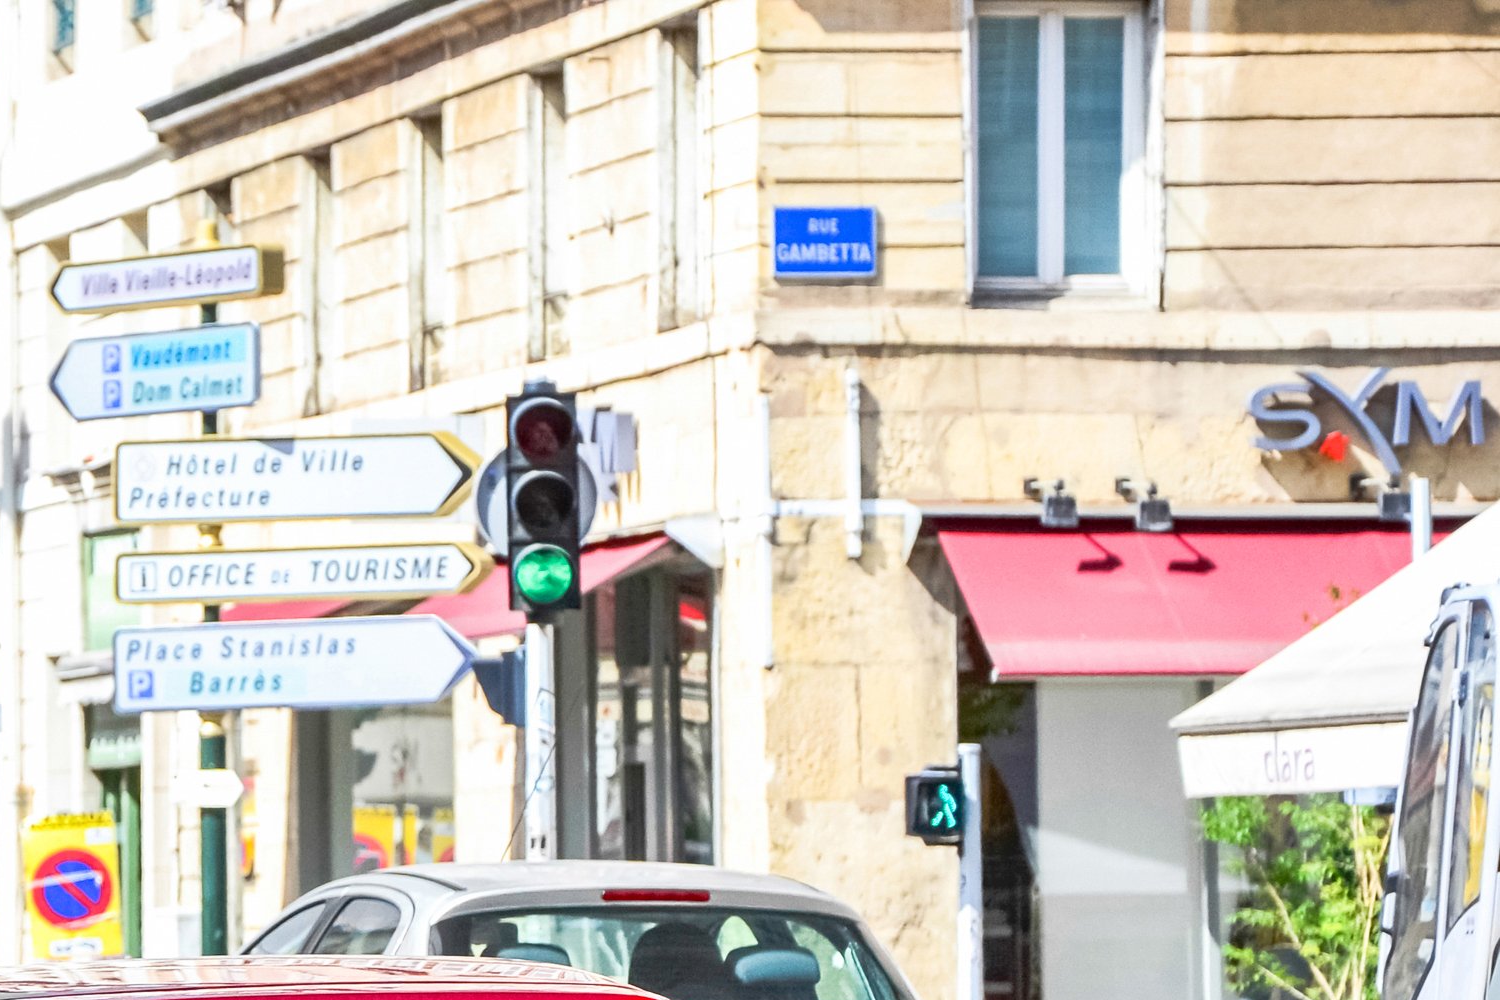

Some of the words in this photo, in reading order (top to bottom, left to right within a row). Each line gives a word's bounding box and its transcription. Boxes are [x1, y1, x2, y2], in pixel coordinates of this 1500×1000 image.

[808, 217, 839, 234] RUE
[776, 242, 872, 262] GAMBETTA
[81, 271, 118, 296] Ville
[125, 258, 251, 292] Vieille-Léopold
[130, 340, 232, 368] Vaudémont
[133, 381, 172, 404] Dom
[180, 375, 243, 399] Calmet
[166, 453, 238, 477] Hôtel
[254, 453, 282, 474] de
[301, 450, 364, 473] Ville
[128, 486, 272, 509] Préfecture
[168, 563, 256, 587] OFFICE
[271, 570, 291, 584] DE
[310, 556, 449, 583] TOURISME
[126, 639, 204, 661] Place
[220, 635, 357, 658] Stanislas
[190, 672, 283, 696] Barrès
[1263, 741, 1316, 783] clara
